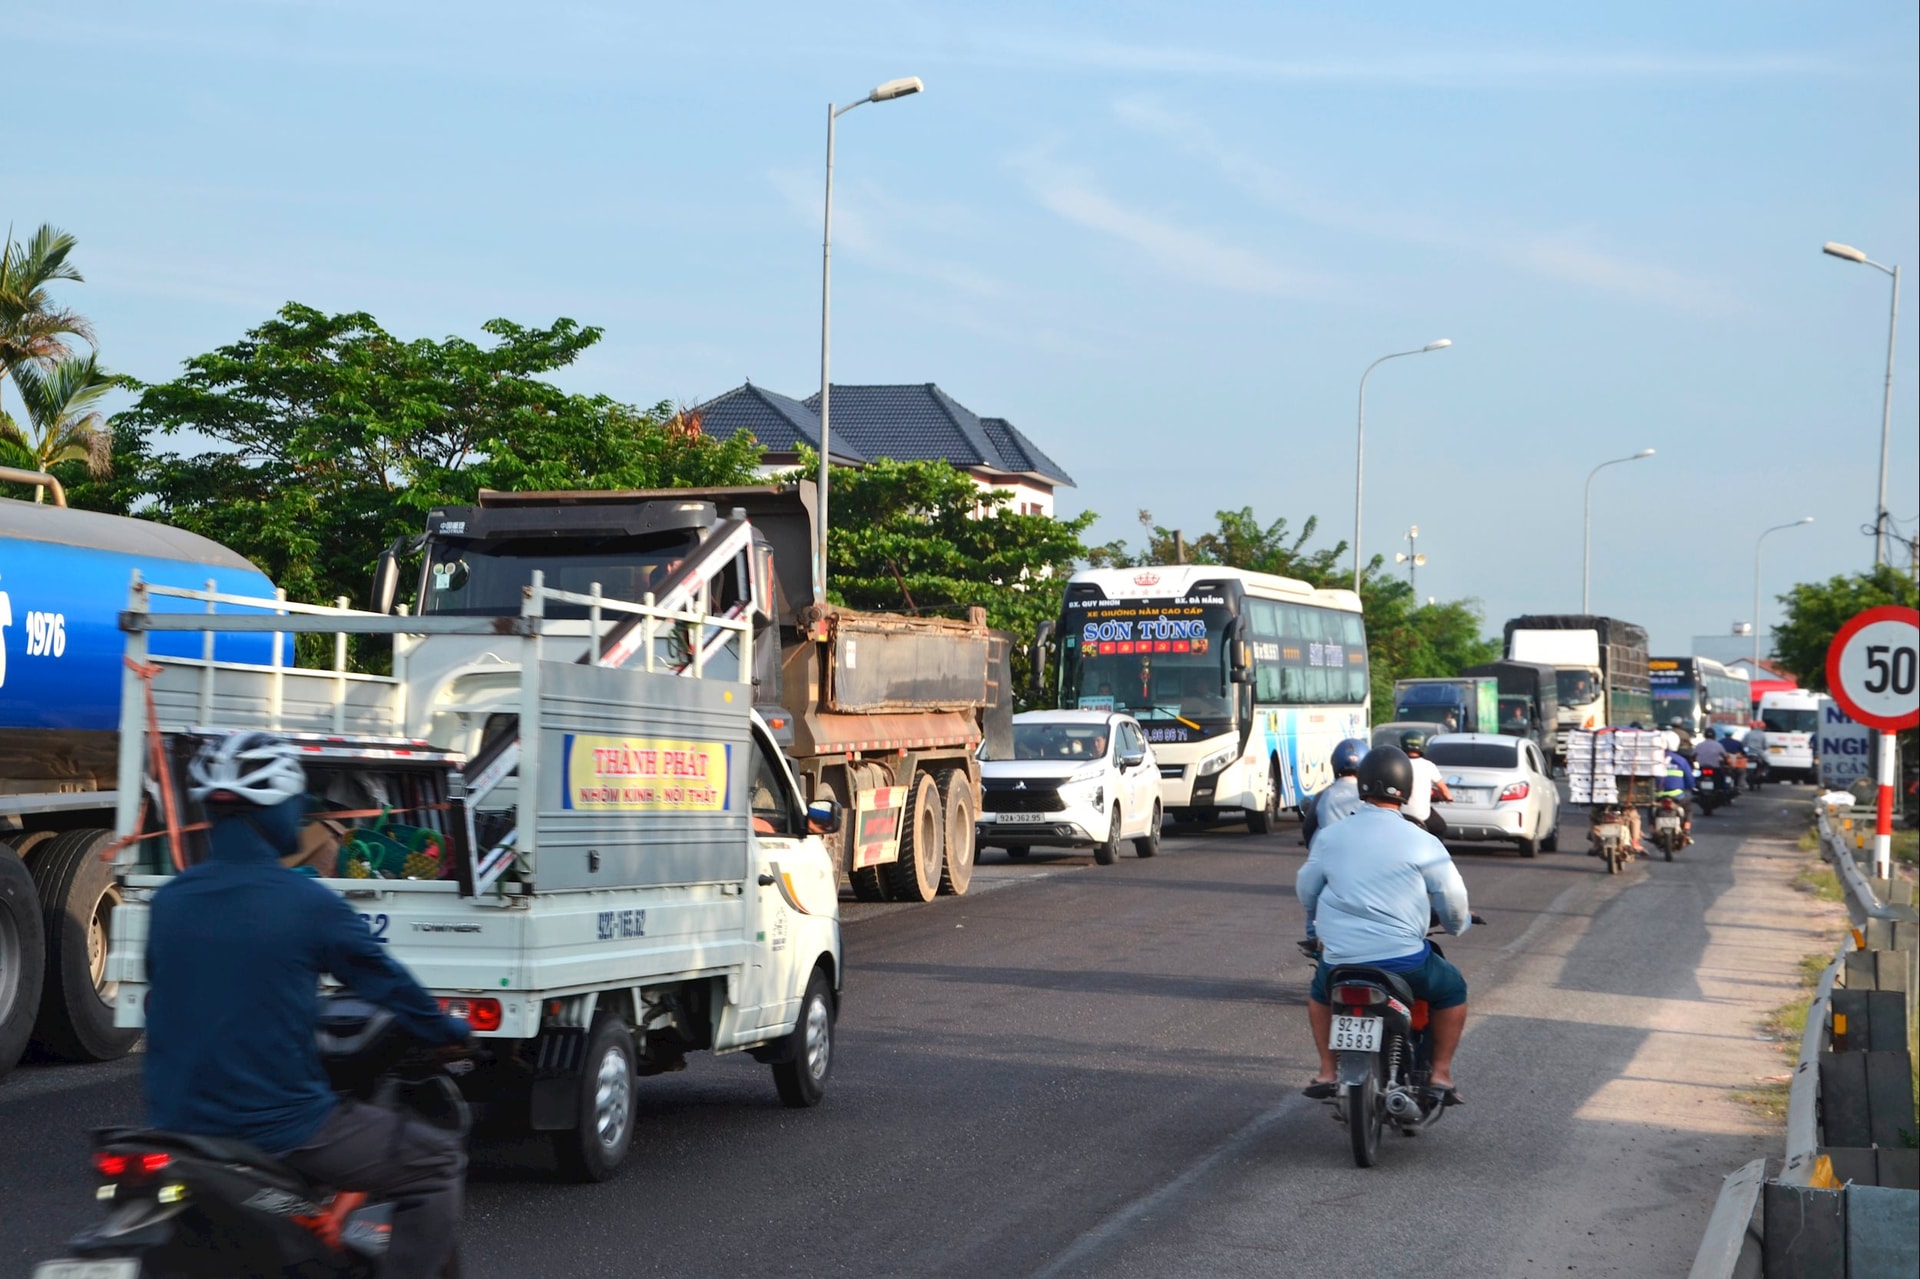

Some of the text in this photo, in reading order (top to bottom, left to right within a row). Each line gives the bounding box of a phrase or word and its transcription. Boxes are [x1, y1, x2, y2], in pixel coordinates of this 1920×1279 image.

[26, 610, 66, 658] 1976
[1083, 615, 1207, 641] SƠN TÙNG
[1864, 645, 1917, 695] 50
[593, 743, 708, 779] THÀNH PHÁT
[580, 784, 620, 804] NHÔM
[622, 785, 655, 804] KÍNH
[664, 786, 684, 806] NỘI
[688, 784, 717, 805] THẤT
[1338, 1017, 1374, 1033] 92-K7
[1336, 1033, 1373, 1049] 9583
